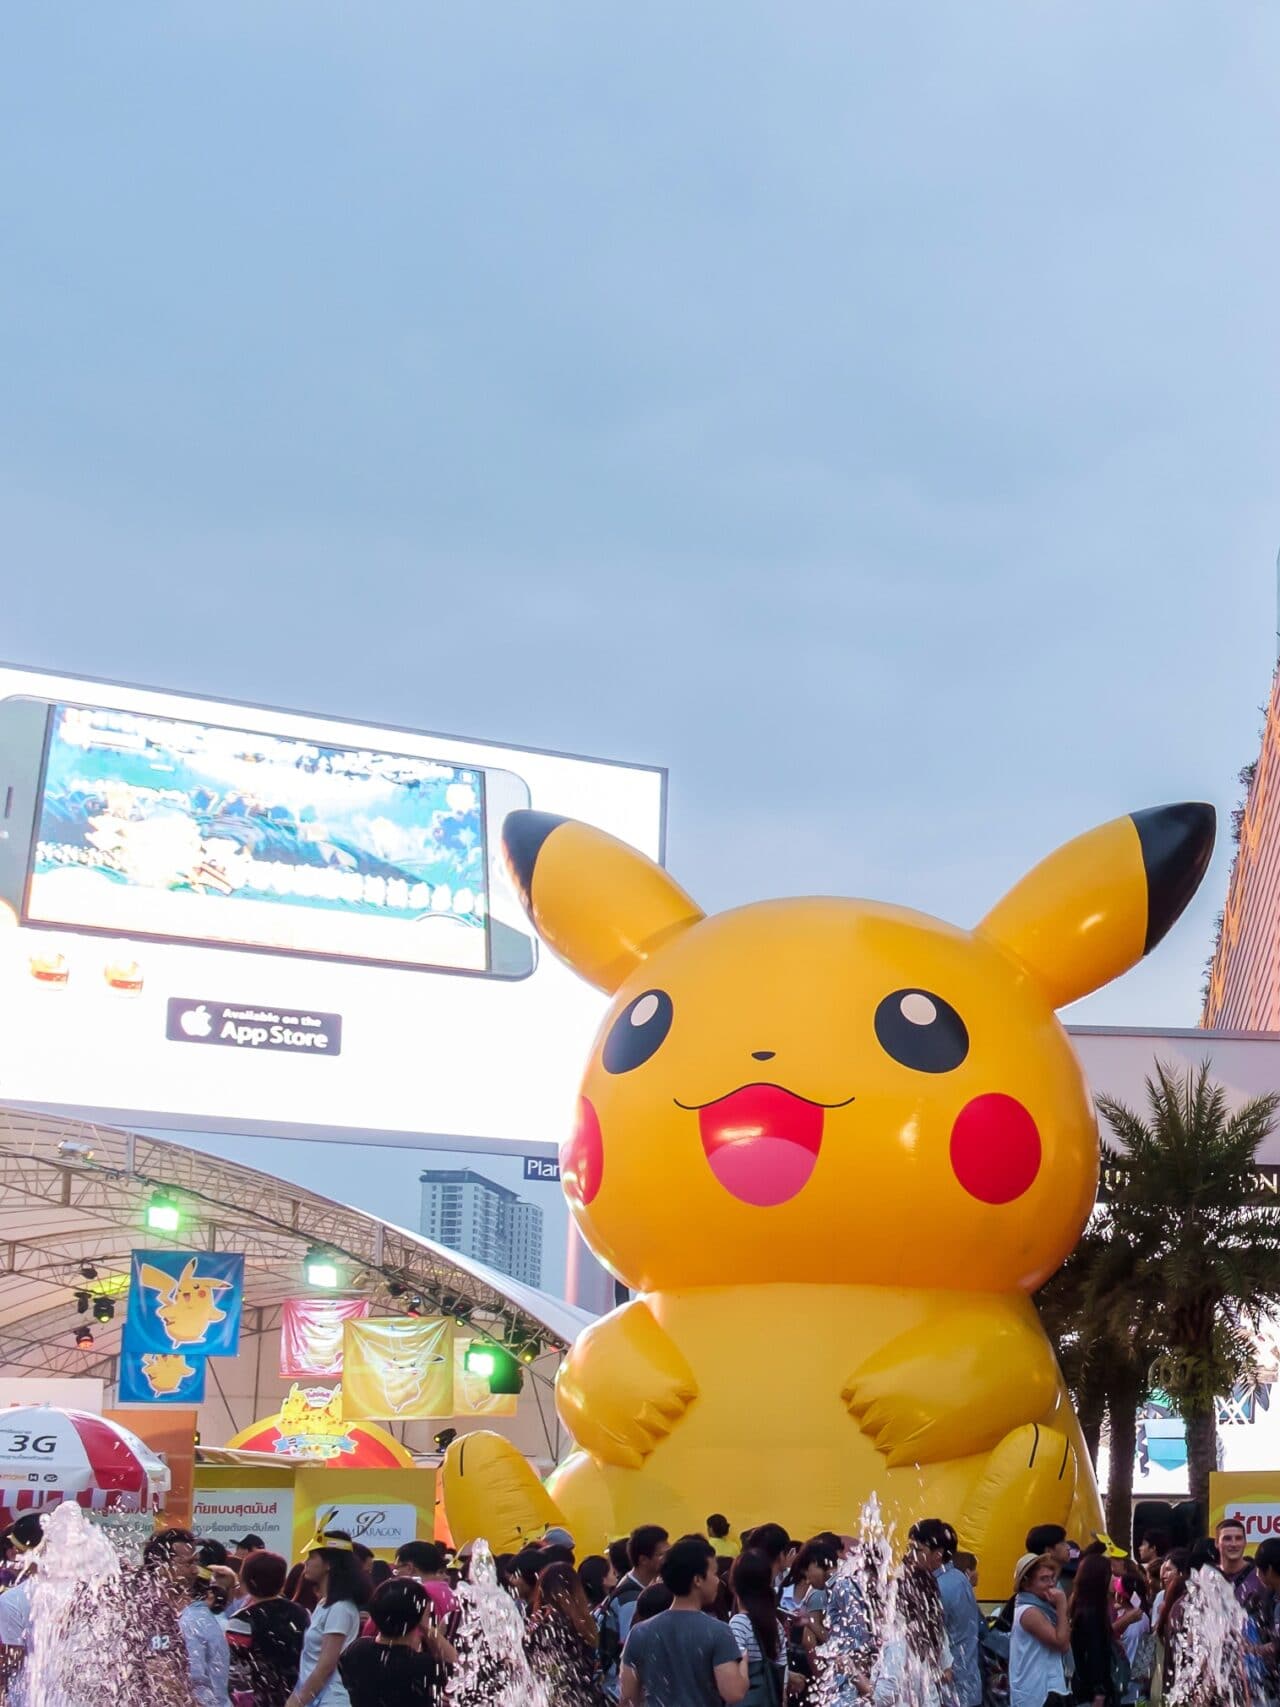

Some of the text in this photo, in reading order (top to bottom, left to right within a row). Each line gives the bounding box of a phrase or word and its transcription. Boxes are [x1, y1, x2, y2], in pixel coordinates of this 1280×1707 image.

[222, 1008, 322, 1027] Available on the
[220, 1021, 329, 1048] App Store
[8, 1435, 58, 1453] 3G
